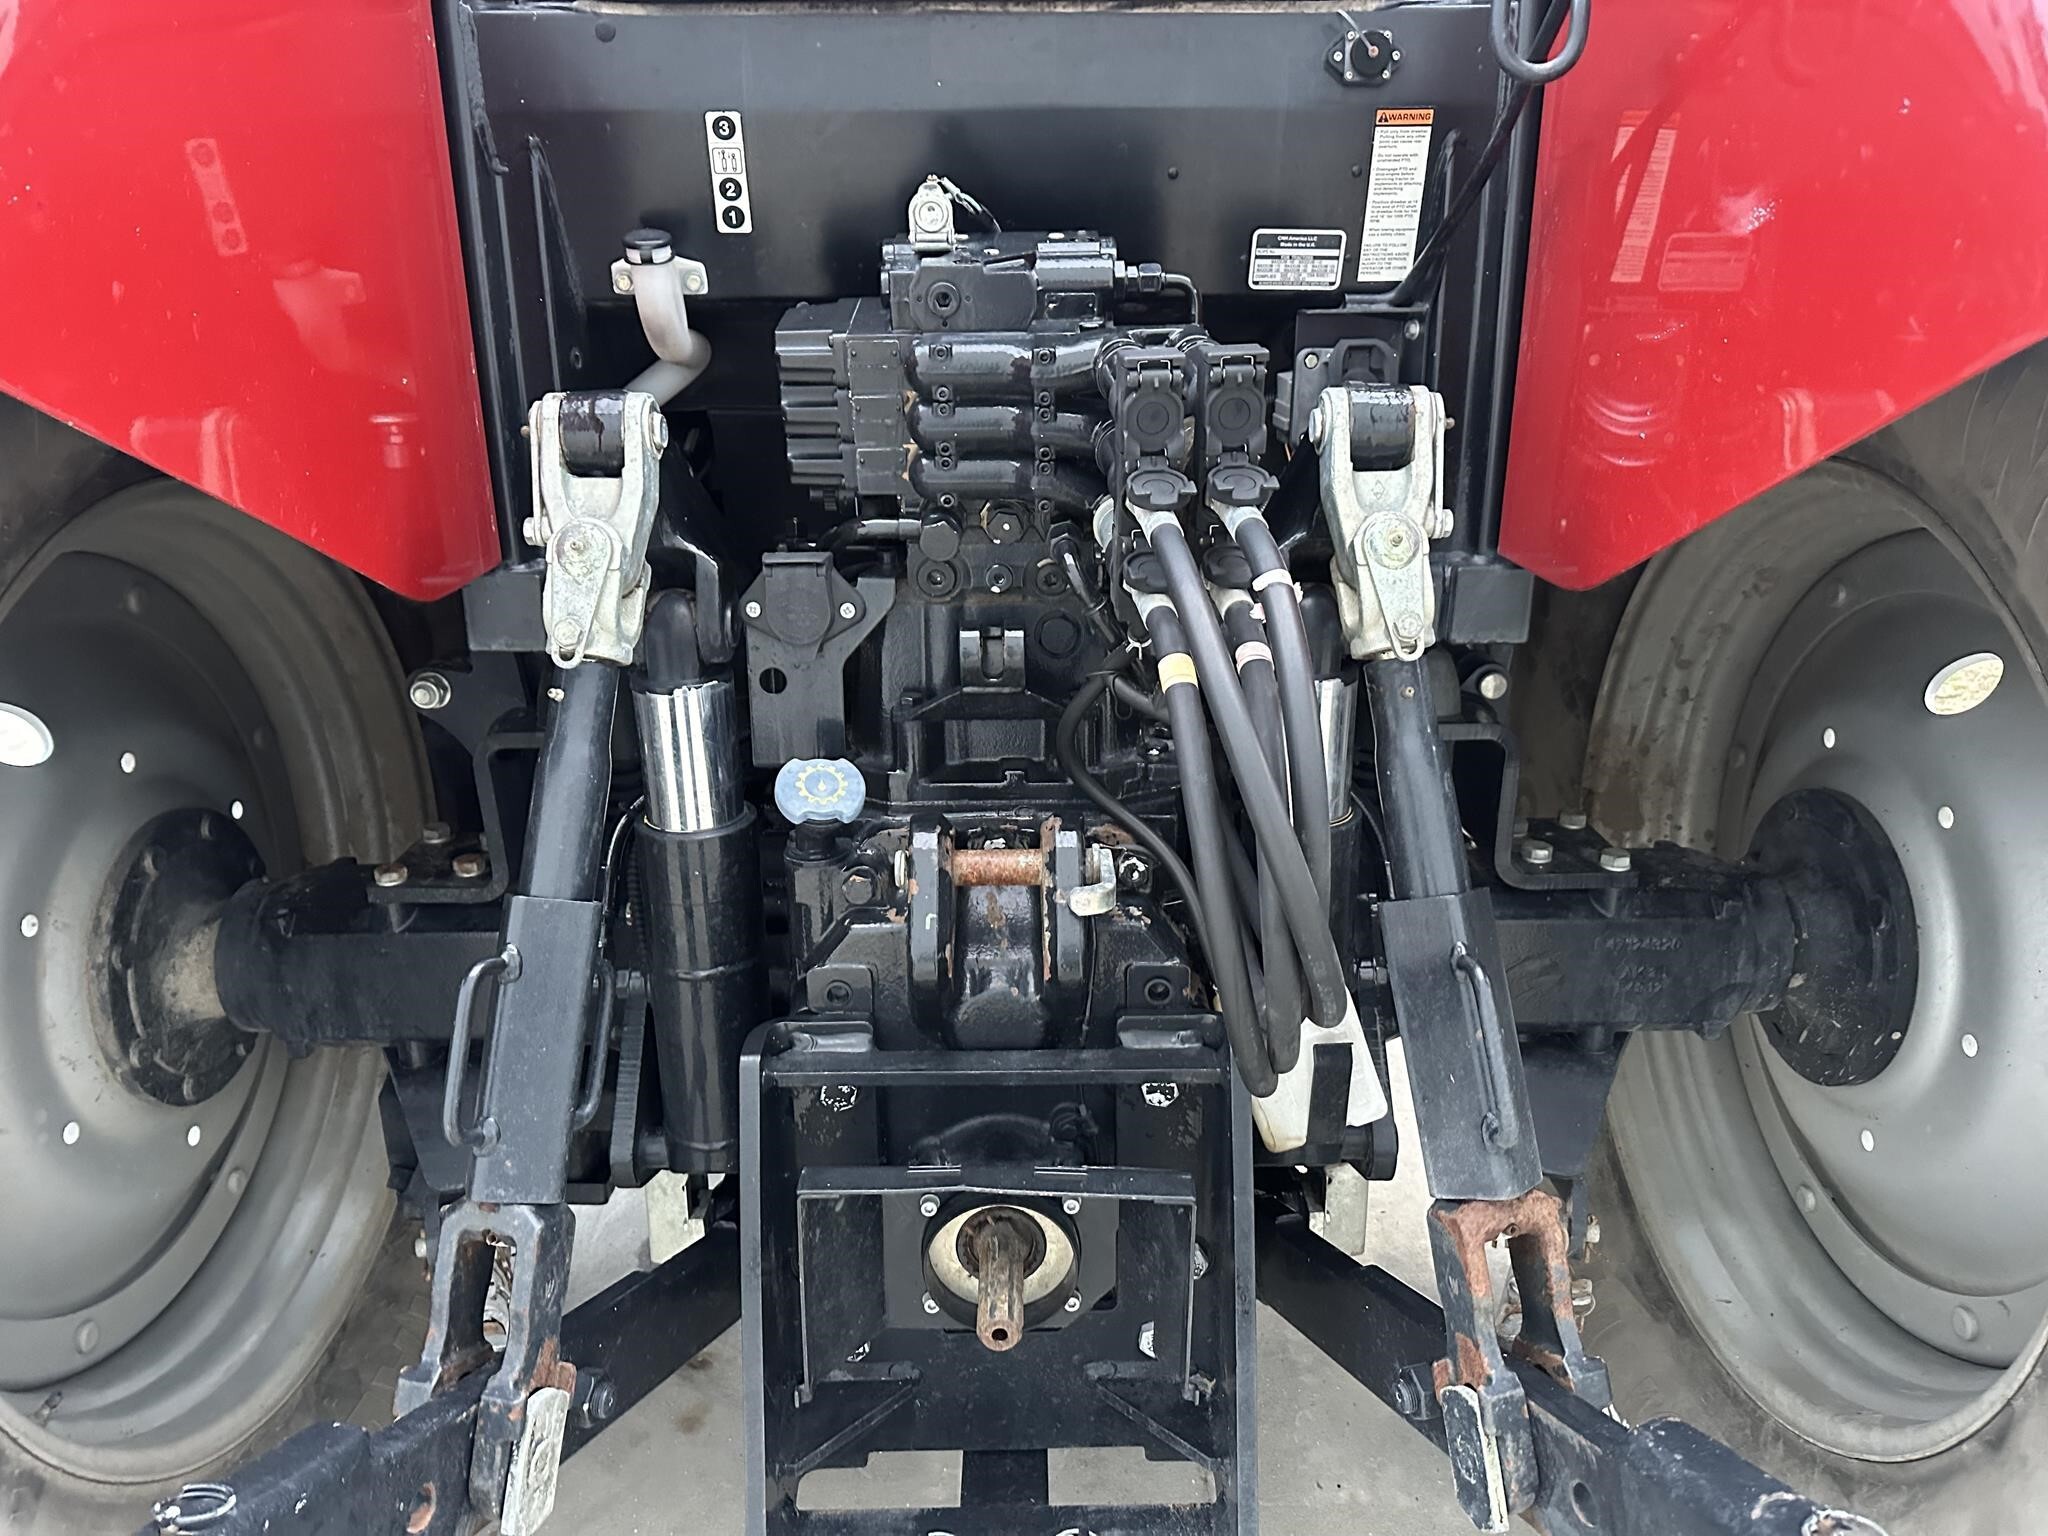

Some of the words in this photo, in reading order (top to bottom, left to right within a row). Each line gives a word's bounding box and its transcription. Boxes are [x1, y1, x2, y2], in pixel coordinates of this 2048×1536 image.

[1388, 112, 1431, 120] WARNING
[719, 120, 730, 136] 3
[726, 182, 736, 197] 2
[729, 210, 737, 224] 1
